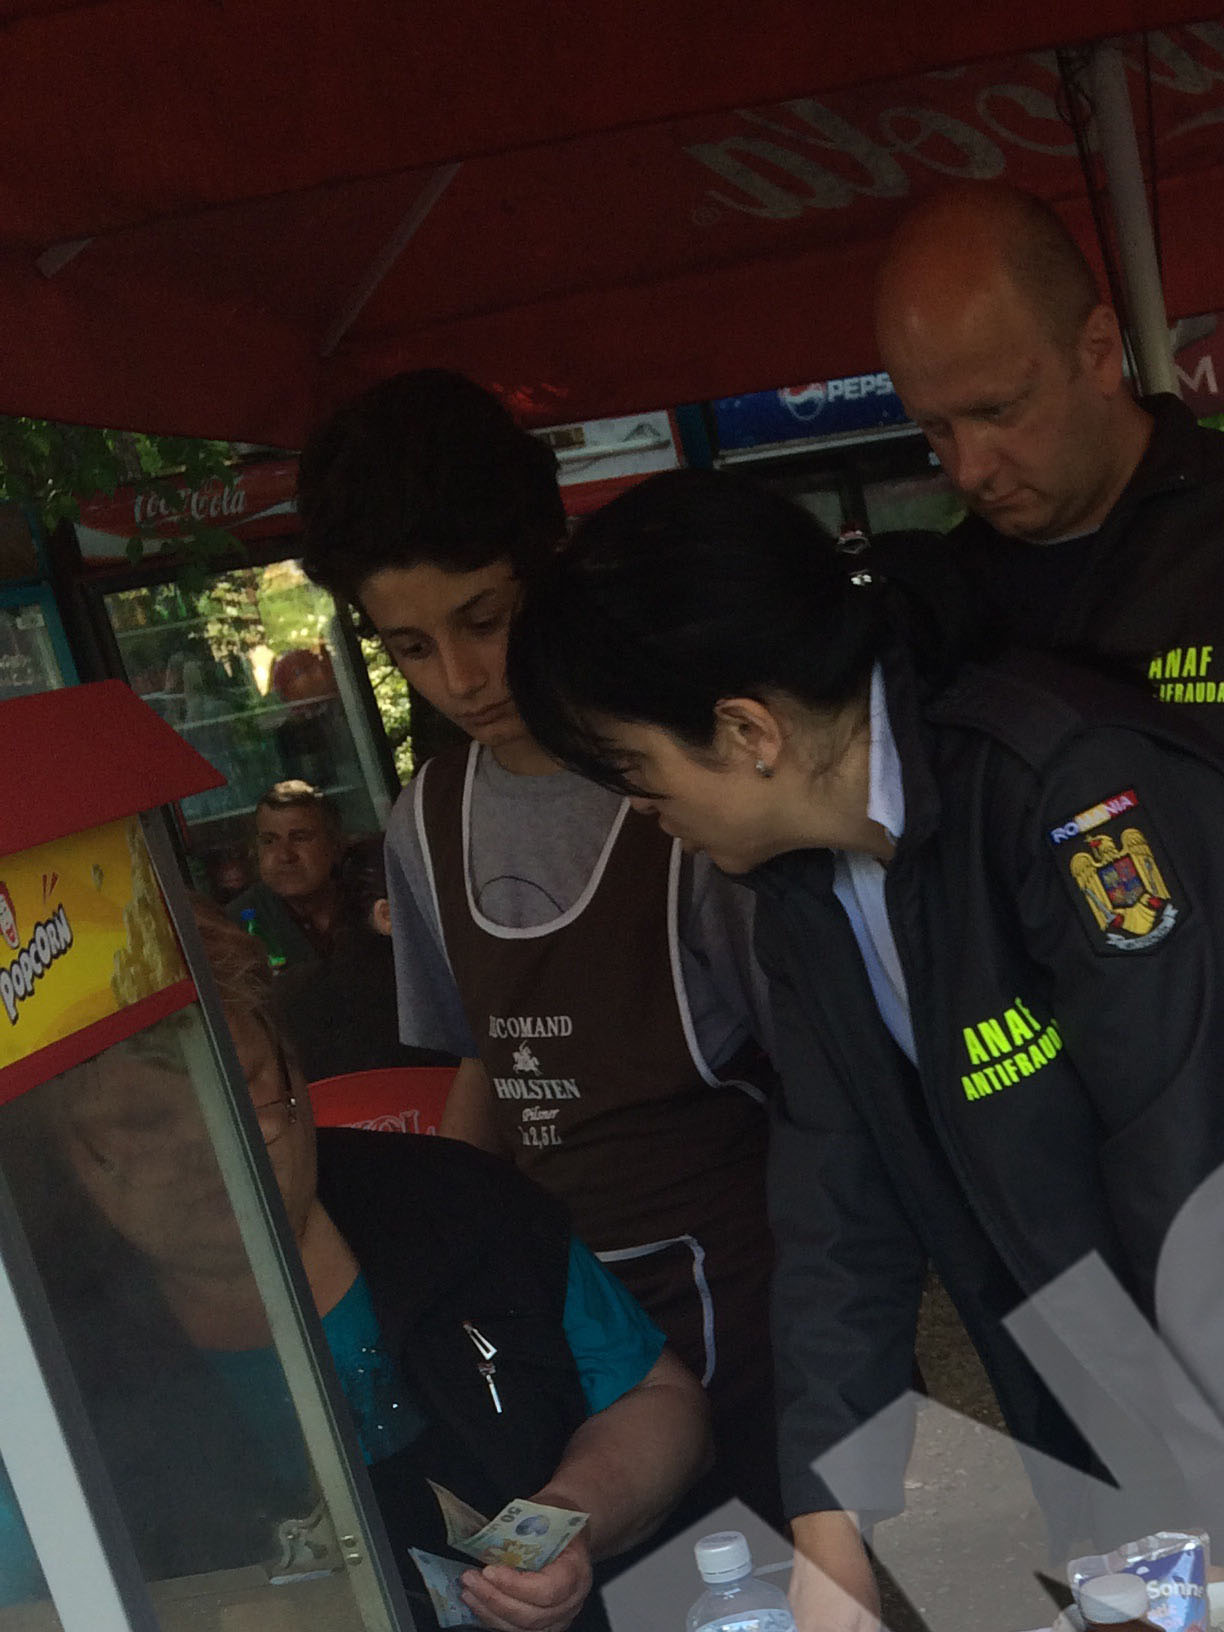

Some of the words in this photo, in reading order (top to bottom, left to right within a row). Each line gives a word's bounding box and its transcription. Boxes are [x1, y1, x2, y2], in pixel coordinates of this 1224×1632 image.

[826, 371, 896, 402] PEPS
[1147, 645, 1214, 679] ANAF
[0, 903, 73, 1025] POPCORN
[960, 1018, 1064, 1102] ANTIFRAUD
[493, 1077, 582, 1100] HOLSTEN
